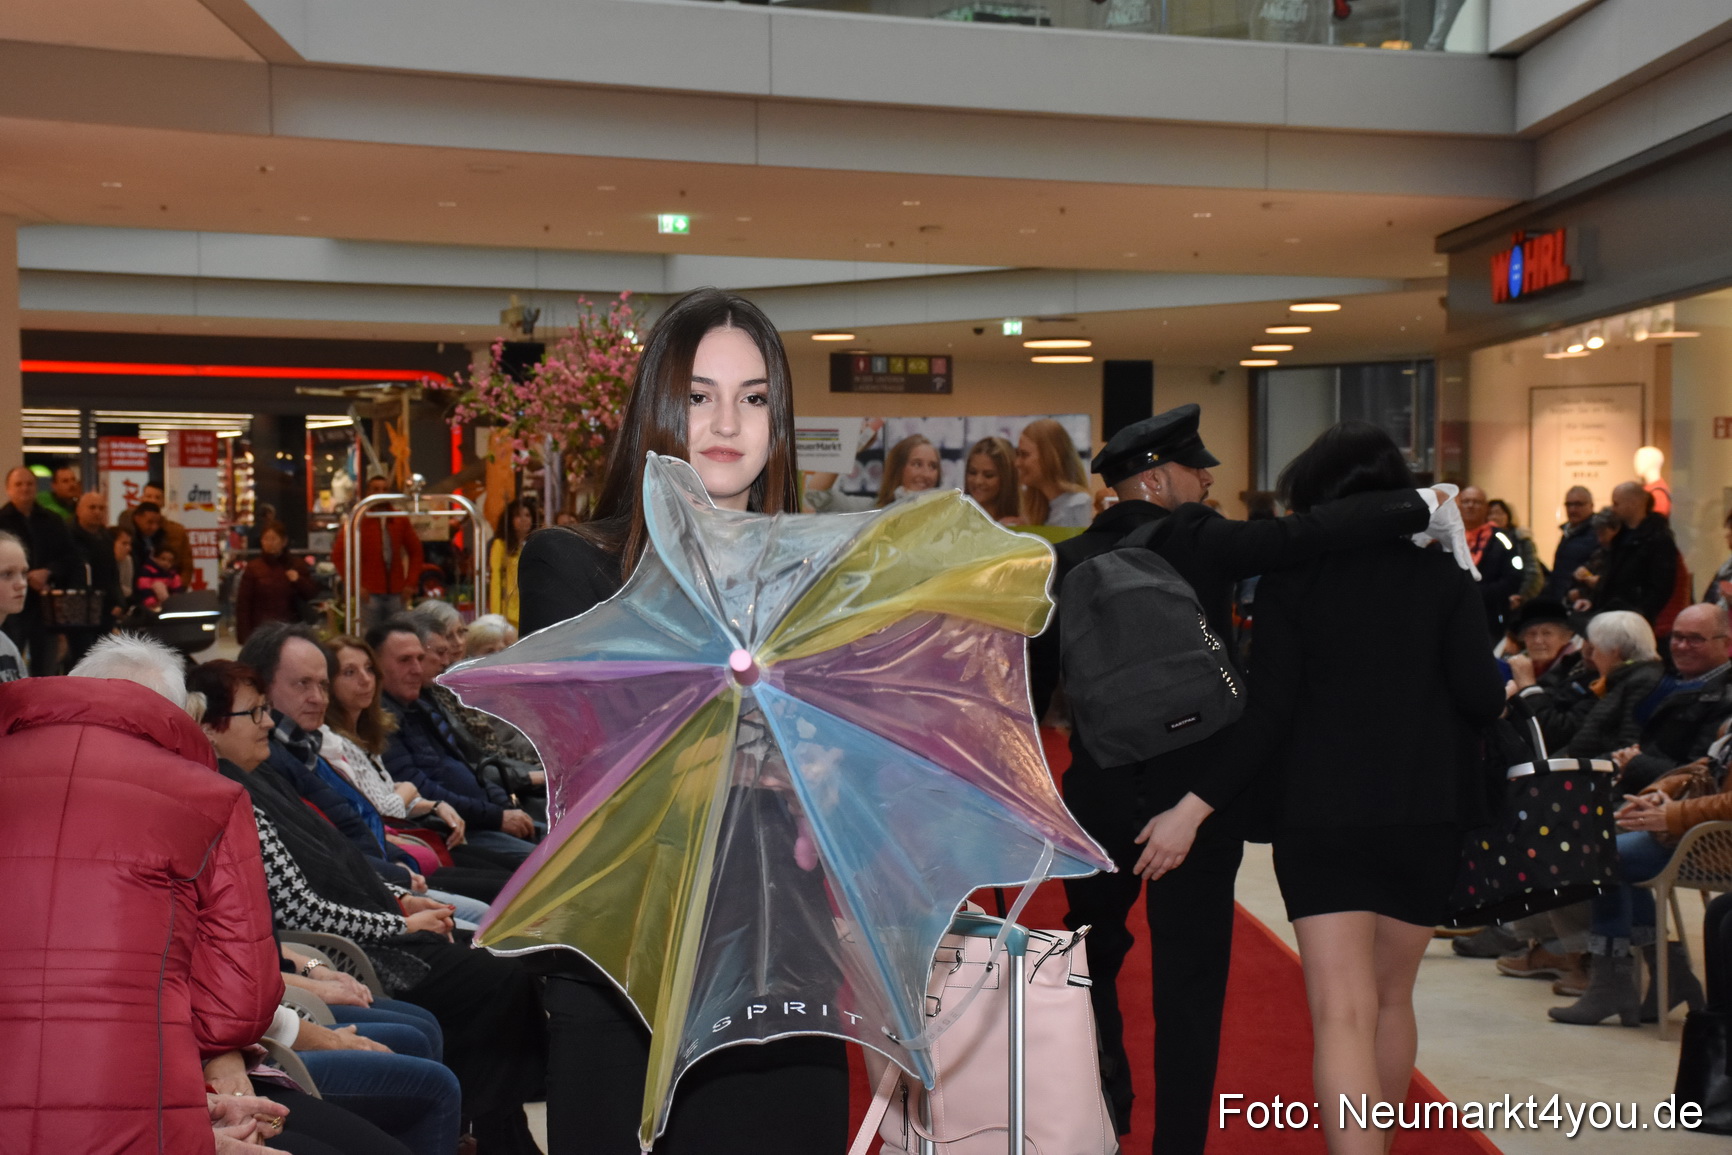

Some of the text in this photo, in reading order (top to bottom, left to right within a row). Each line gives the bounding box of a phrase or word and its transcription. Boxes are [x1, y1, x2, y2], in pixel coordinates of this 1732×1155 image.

[1490, 228, 1570, 304] WÖHRL
[796, 442, 842, 451] euerMarkt
[187, 484, 212, 503] dm
[189, 531, 218, 545] EWE
